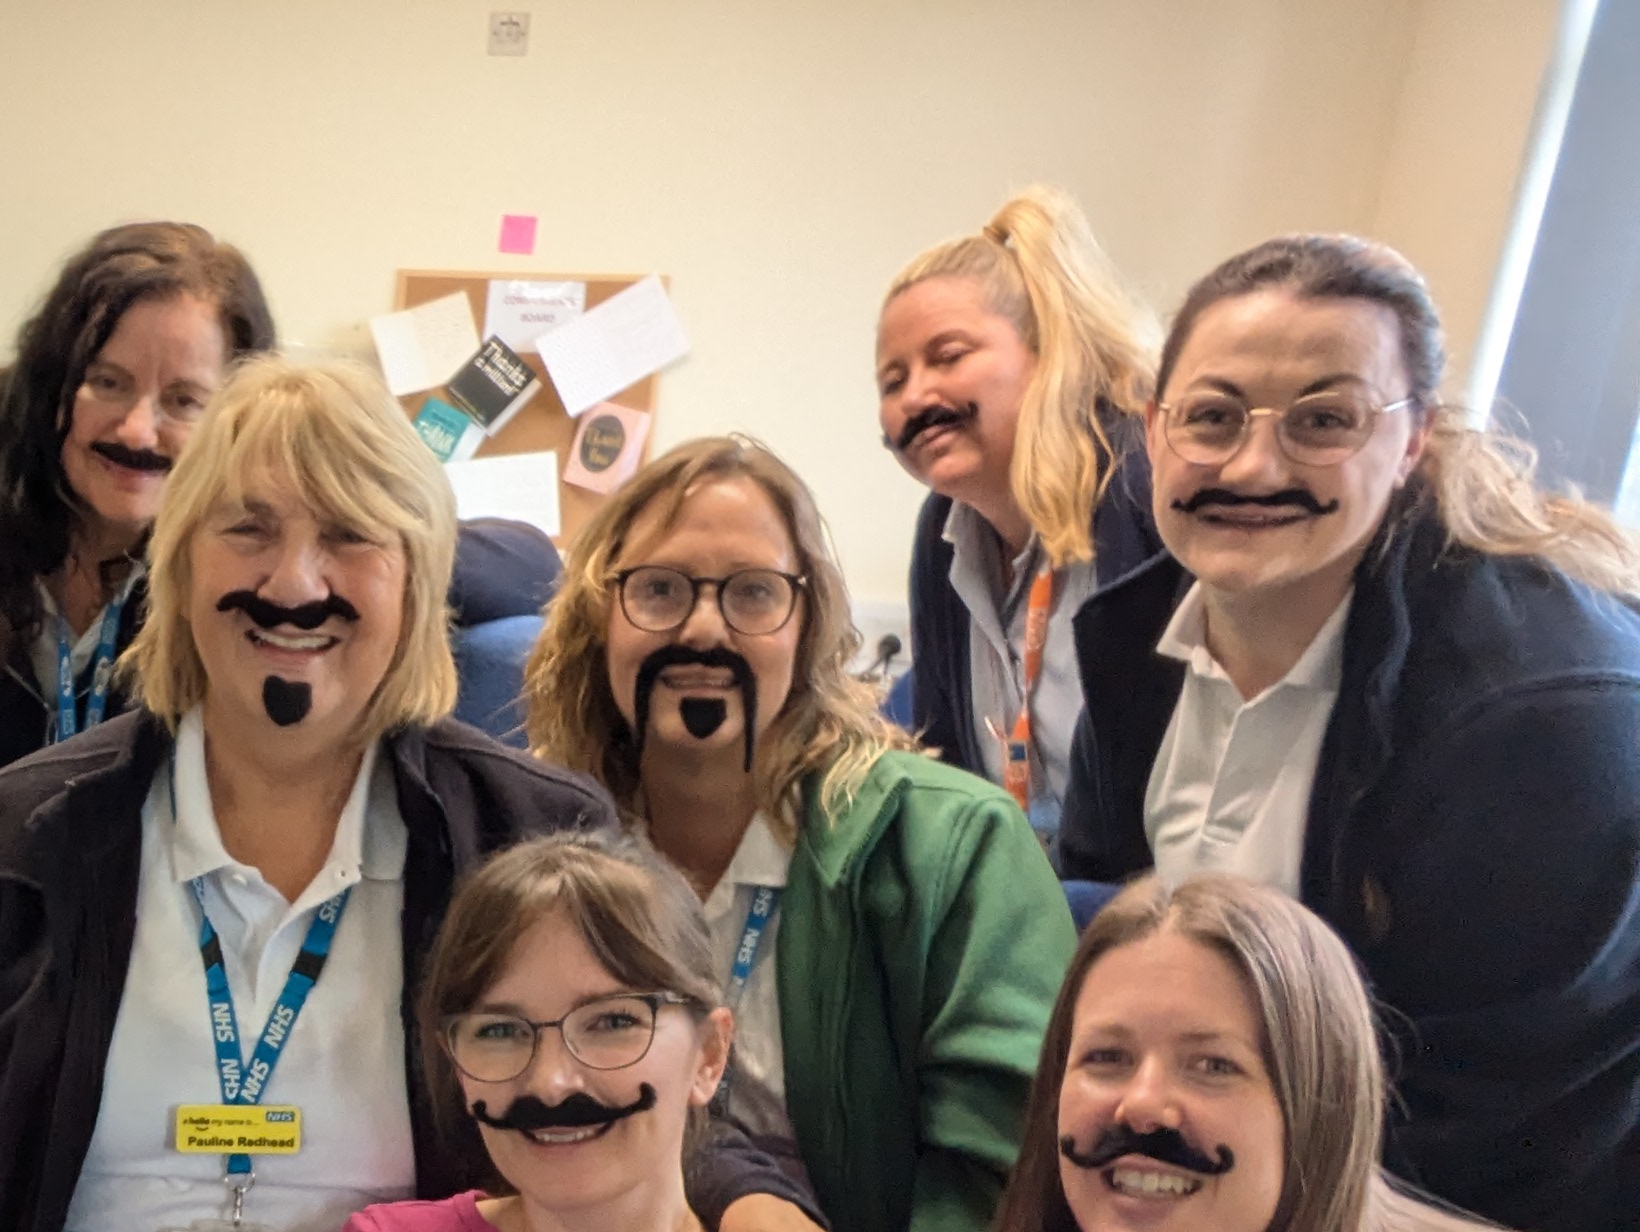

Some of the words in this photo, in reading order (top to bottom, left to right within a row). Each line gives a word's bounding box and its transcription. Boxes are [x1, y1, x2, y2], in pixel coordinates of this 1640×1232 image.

[738, 928, 760, 963] NHS
[212, 1003, 235, 1042] NHS
[263, 1004, 294, 1049] NHS
[240, 1058, 269, 1102] NHS
[266, 1112, 294, 1121] NHS
[187, 1136, 233, 1147] Pauline
[237, 1136, 294, 1148] Redhead
